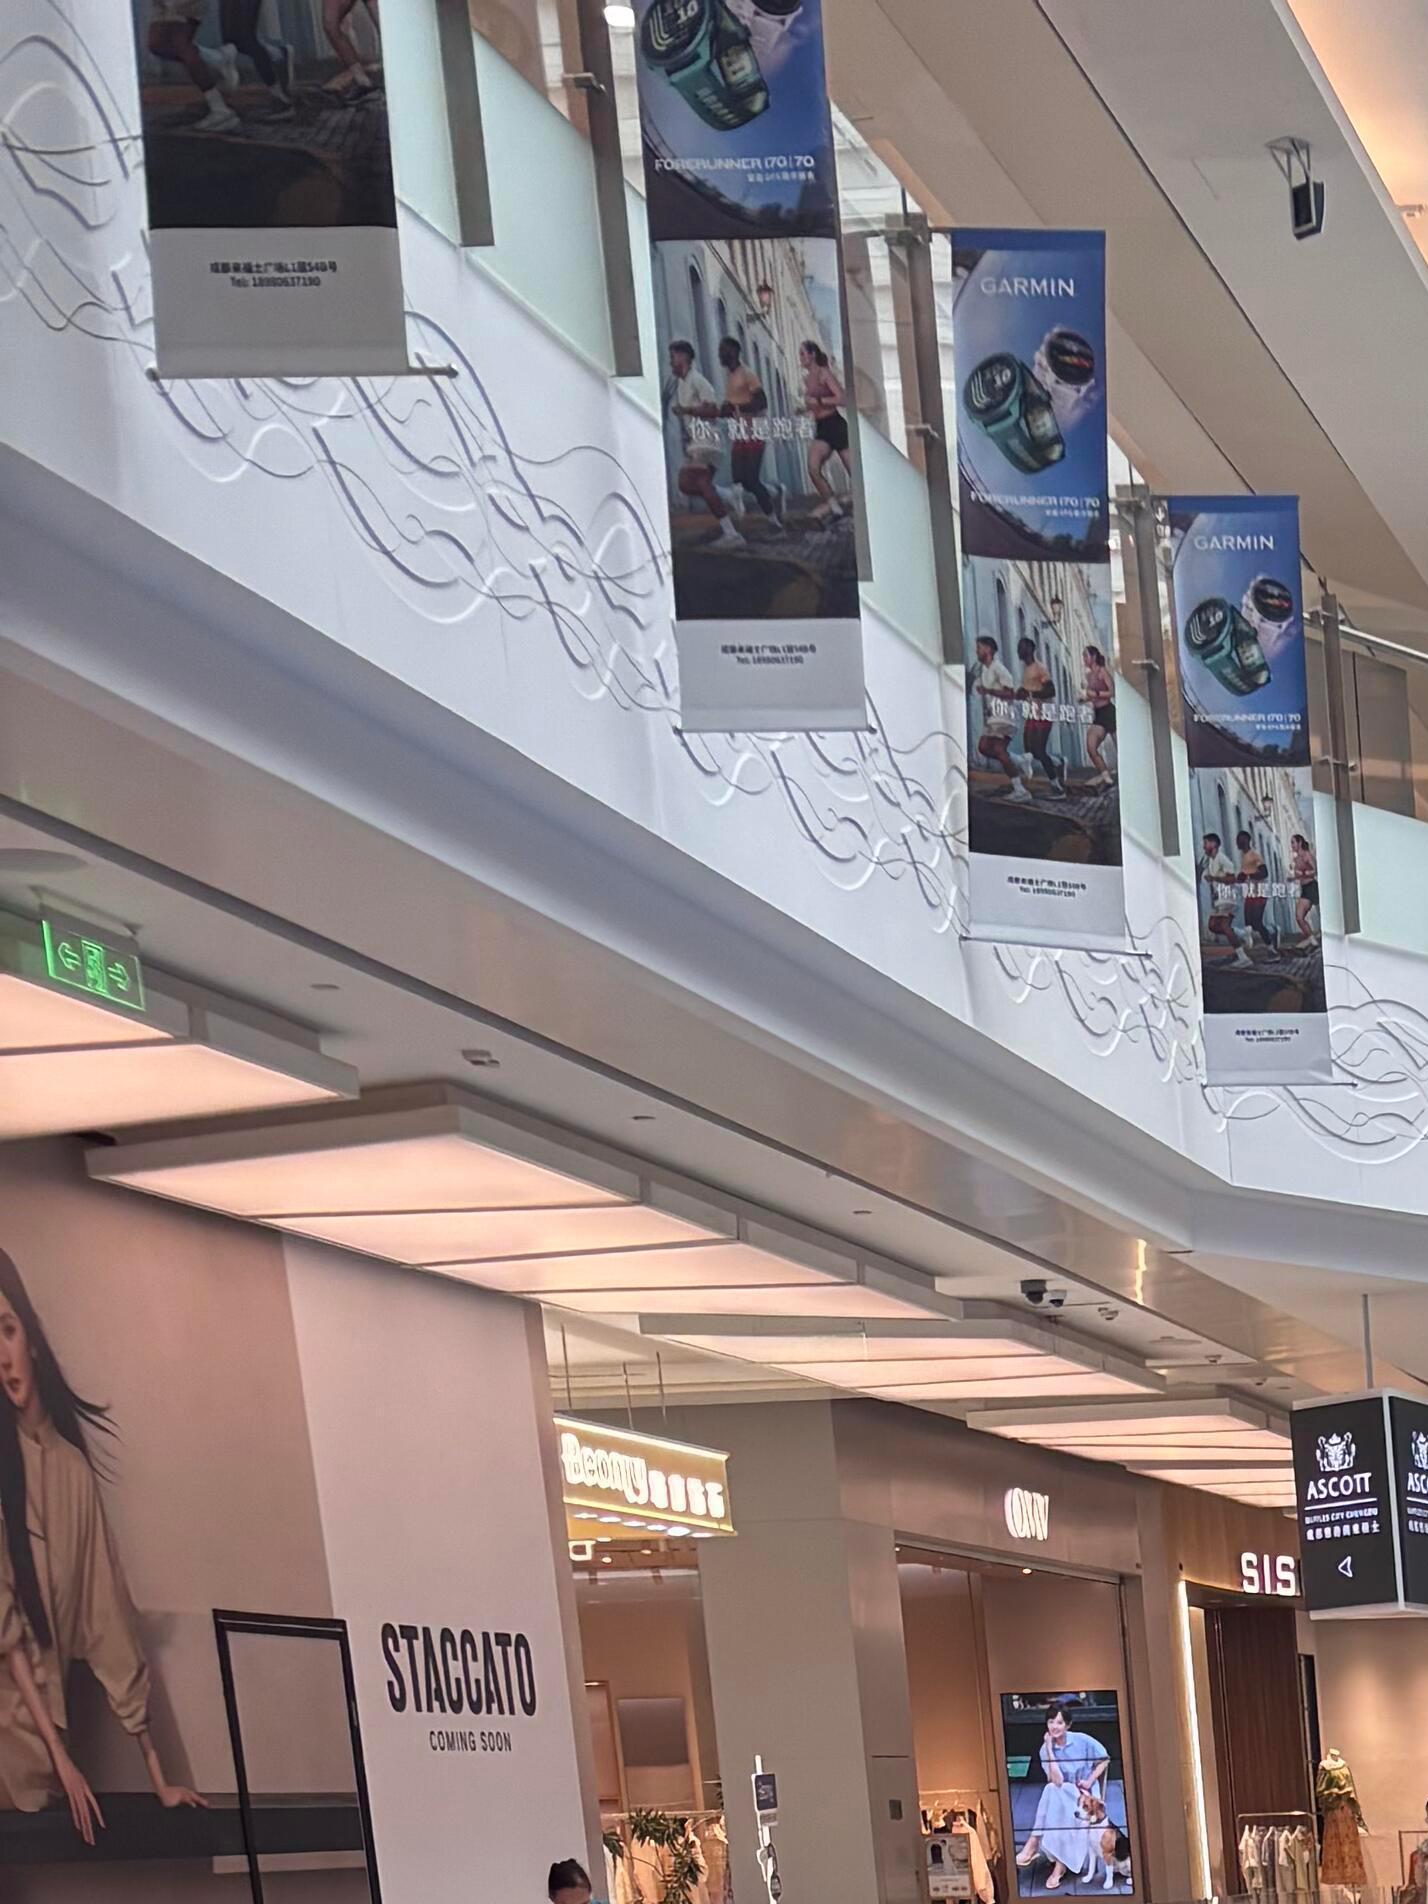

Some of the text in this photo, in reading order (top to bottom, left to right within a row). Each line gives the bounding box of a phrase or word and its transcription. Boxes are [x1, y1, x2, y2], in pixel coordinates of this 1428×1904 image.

[981, 276, 1075, 297] GARMIN
[1194, 534, 1274, 550] GARMIN
[1307, 1472, 1372, 1500] ASCOTT
[381, 1621, 538, 1717] STACCATO
[429, 1729, 513, 1752] COMING SOON
